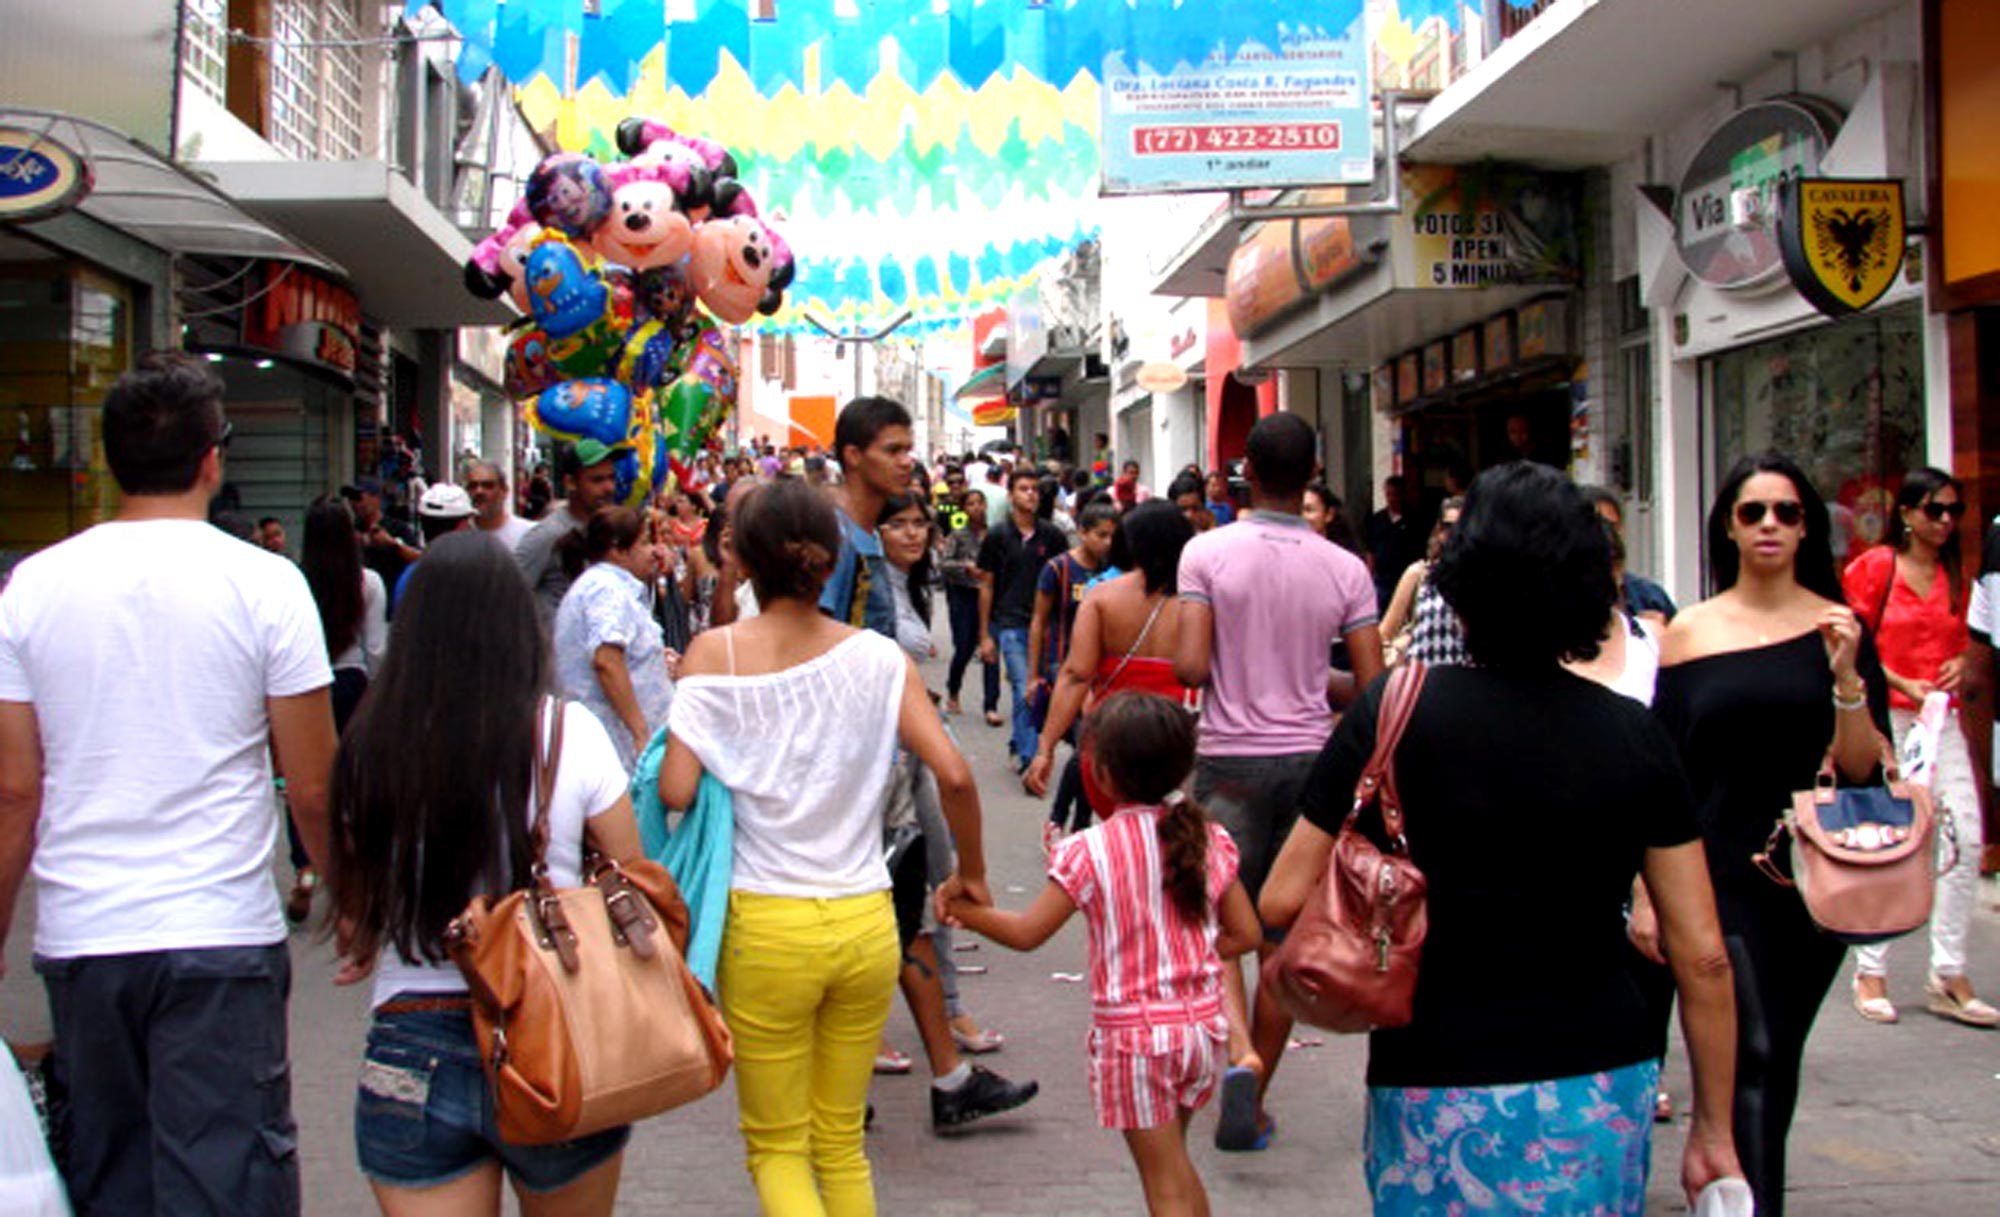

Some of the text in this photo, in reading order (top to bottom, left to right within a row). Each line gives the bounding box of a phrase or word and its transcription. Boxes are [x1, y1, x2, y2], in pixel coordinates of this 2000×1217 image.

[1144, 126, 1335, 153] (77) 422-2510
[1808, 189, 1892, 202] CAVALERA
[1692, 193, 1725, 230] Via
[1432, 262, 1446, 284] 5
